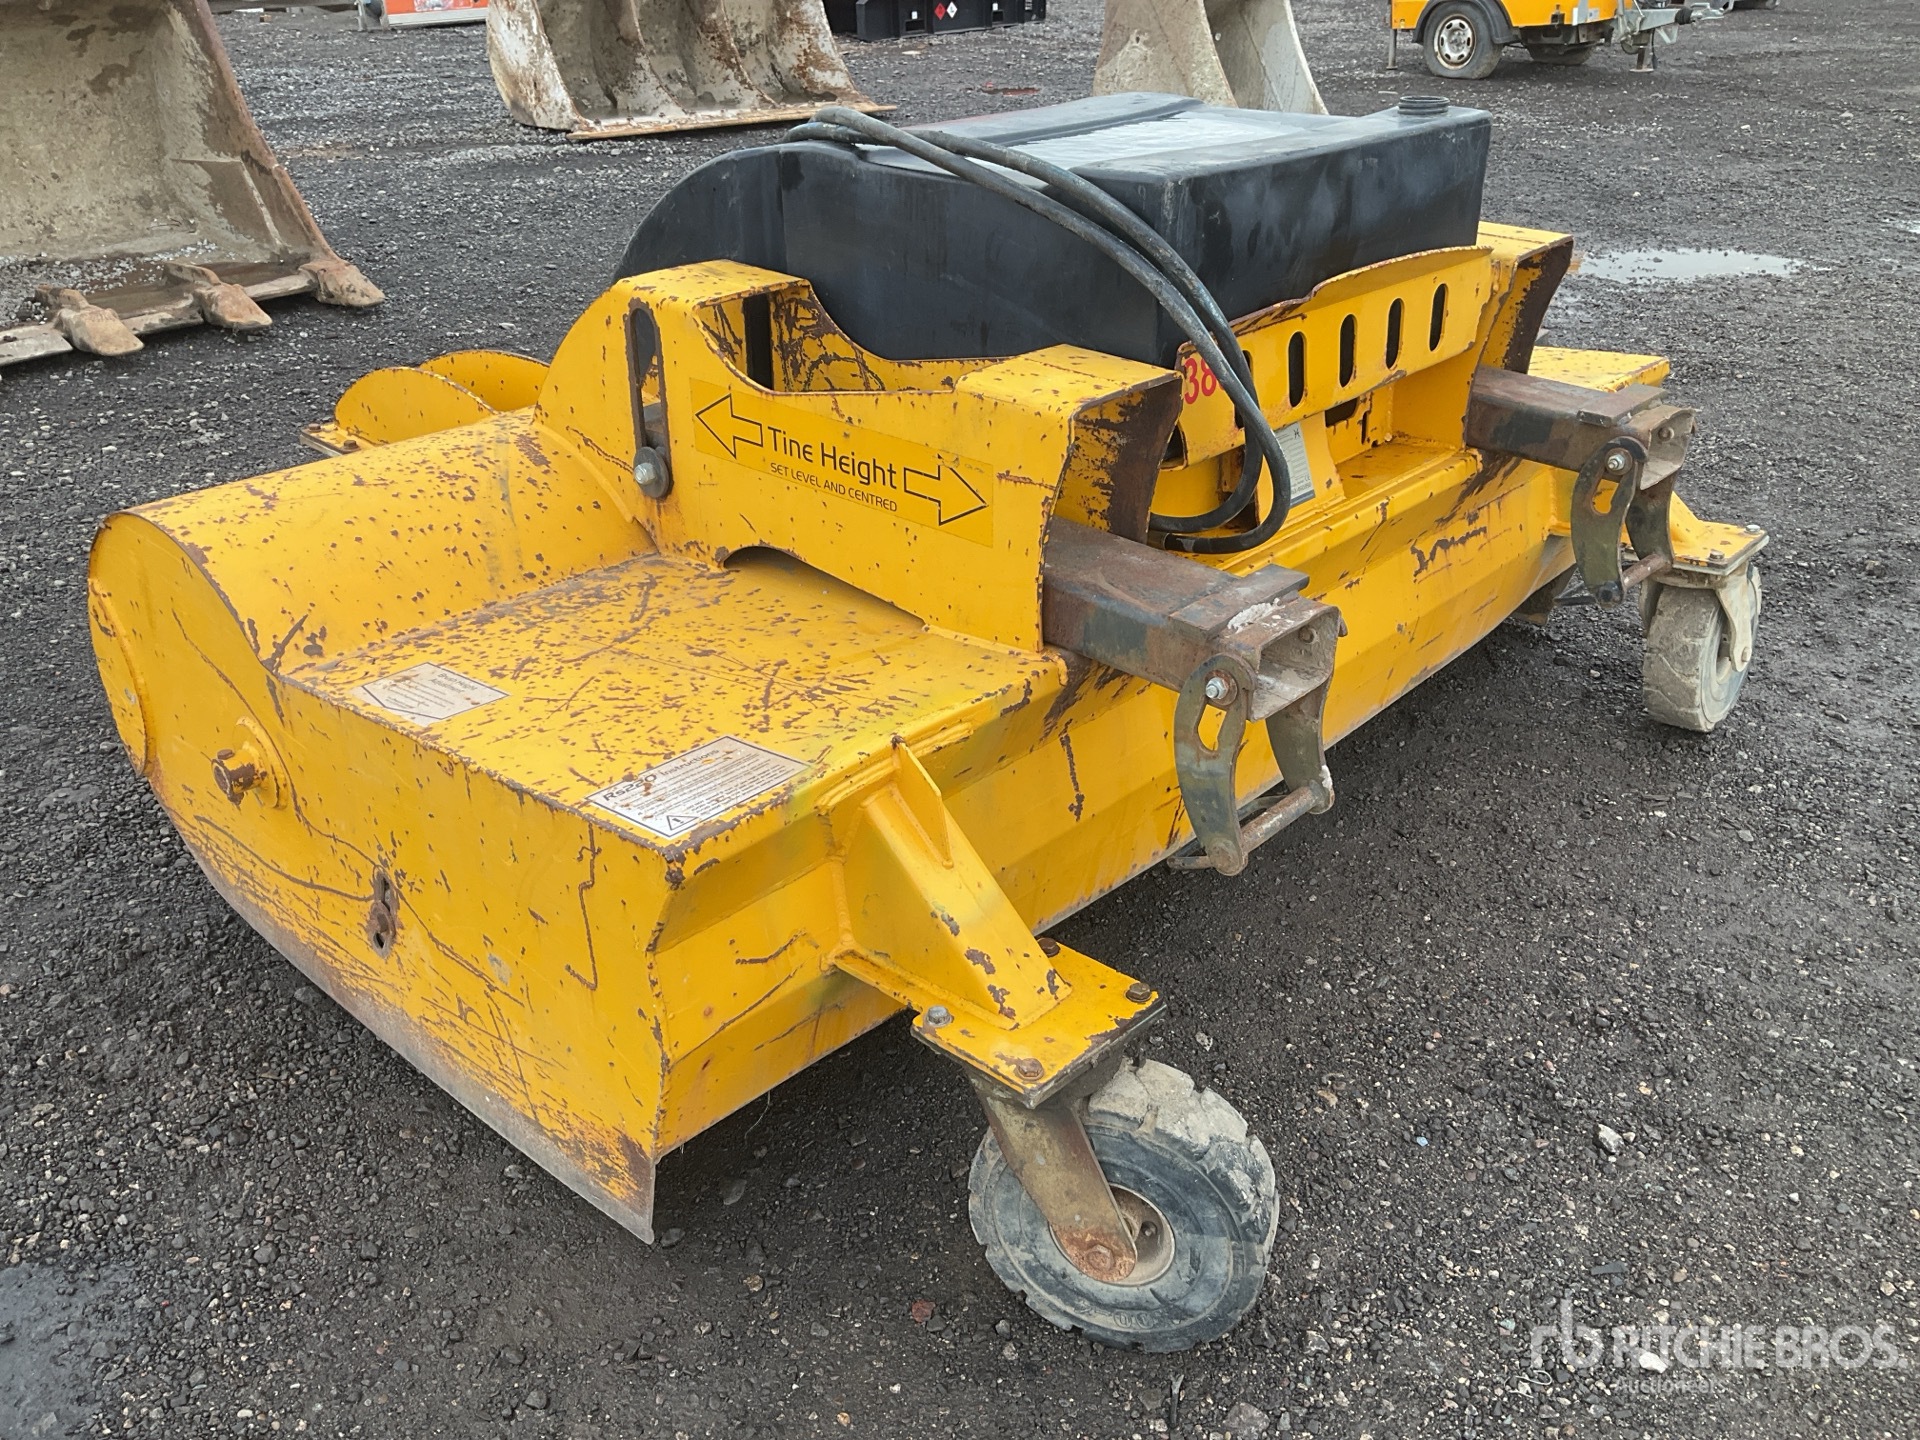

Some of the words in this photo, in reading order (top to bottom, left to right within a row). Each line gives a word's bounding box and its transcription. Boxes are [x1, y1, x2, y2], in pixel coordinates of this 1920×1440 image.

[767, 426, 813, 463] Tine
[820, 442, 897, 490] Height
[770, 462, 789, 477] SET
[790, 469, 822, 488] LEVEL
[823, 480, 846, 495] AND
[848, 487, 898, 512] CENTRED
[660, 748, 720, 777] Instructions
